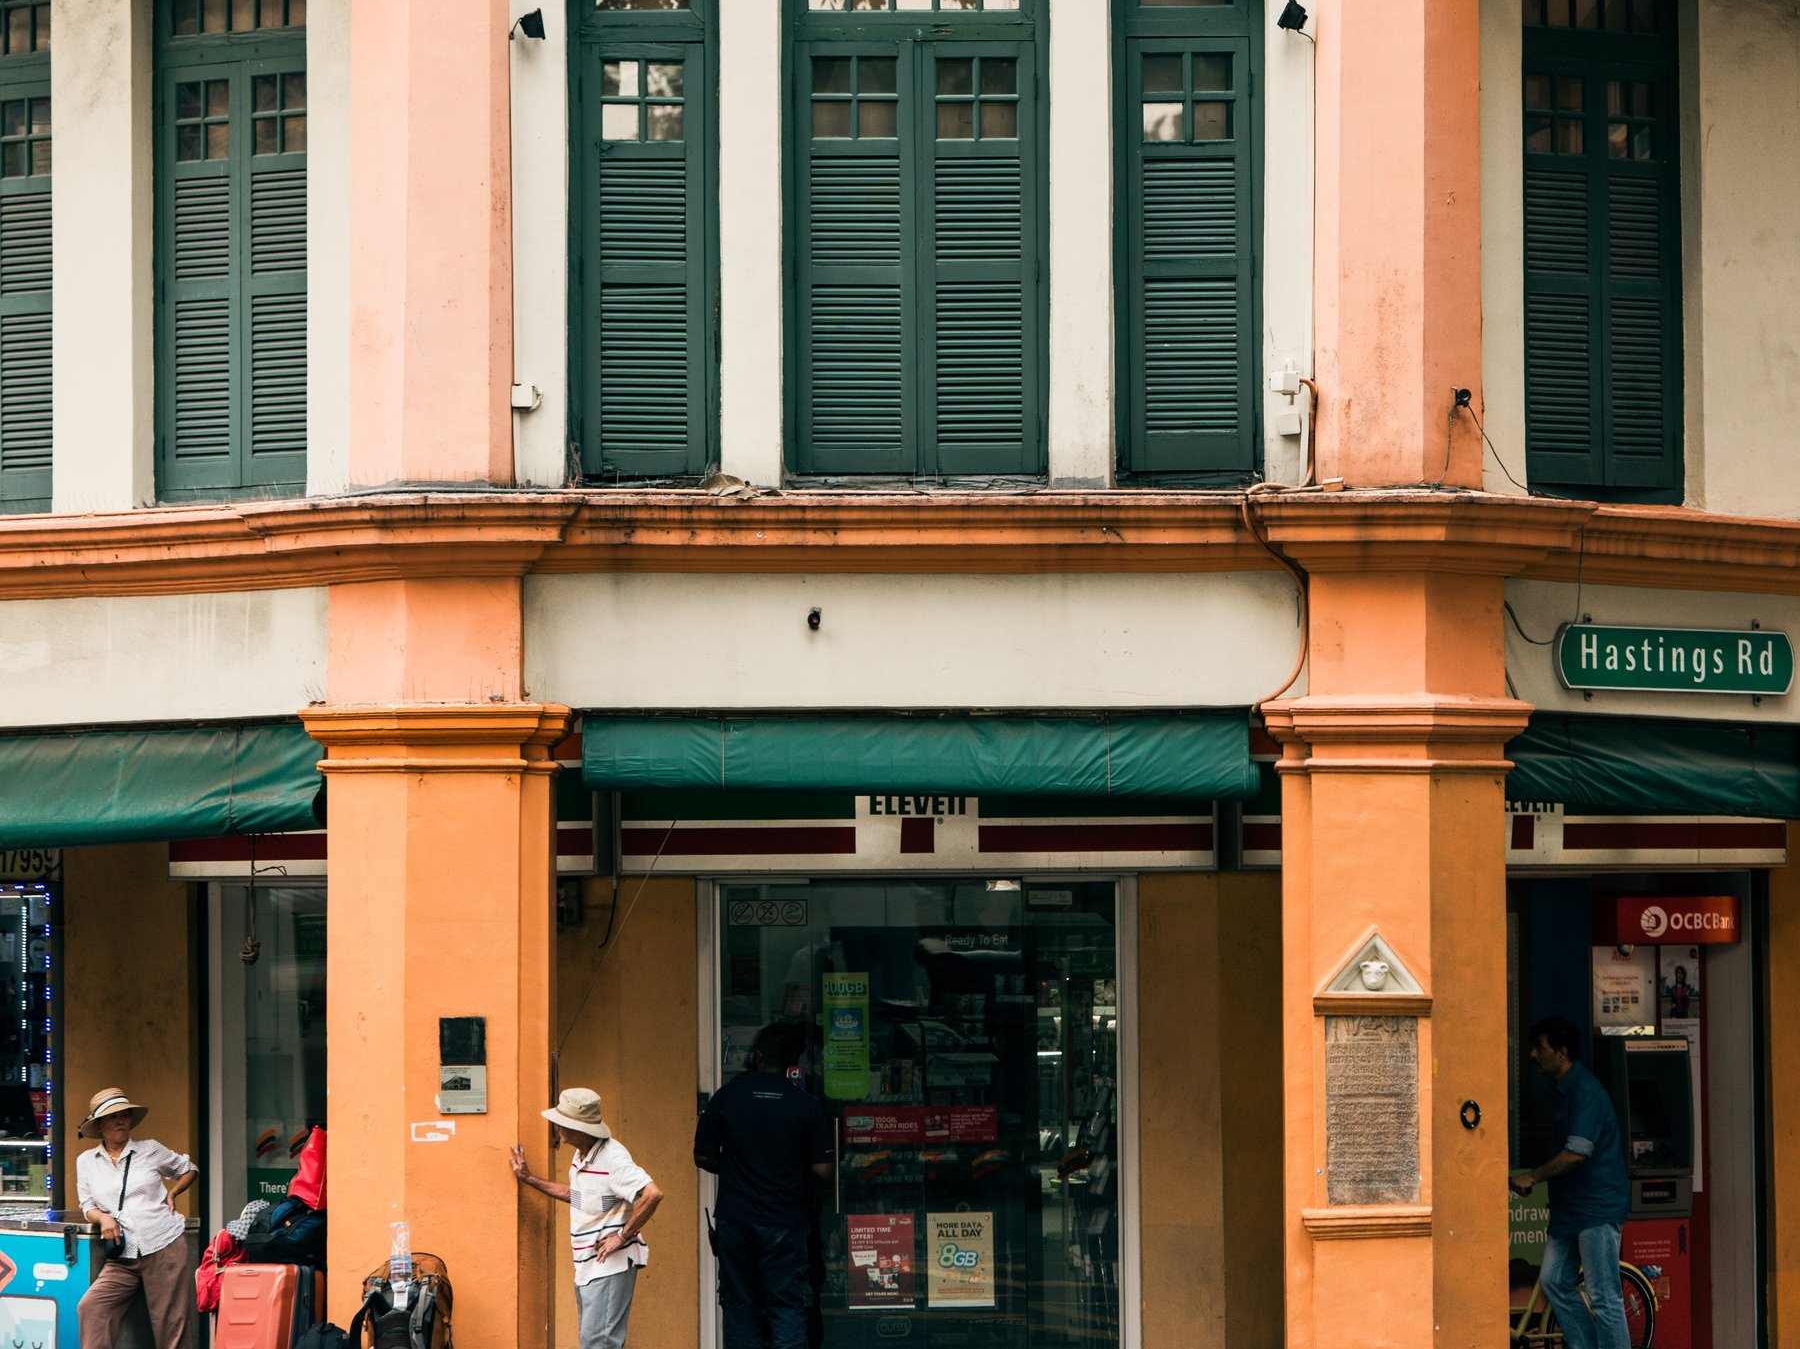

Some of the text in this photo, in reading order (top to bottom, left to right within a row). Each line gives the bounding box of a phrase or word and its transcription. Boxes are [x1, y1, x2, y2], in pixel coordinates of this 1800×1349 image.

[1581, 634, 1773, 682] Hastings Rd
[1670, 912, 1735, 930] OCBC Bank
[945, 933, 1009, 949] Ready To Eat
[875, 1122, 919, 1130] TRAIN RIDES
[937, 1229, 982, 1238] ALL DAY
[938, 1242, 979, 1269] 8GB
